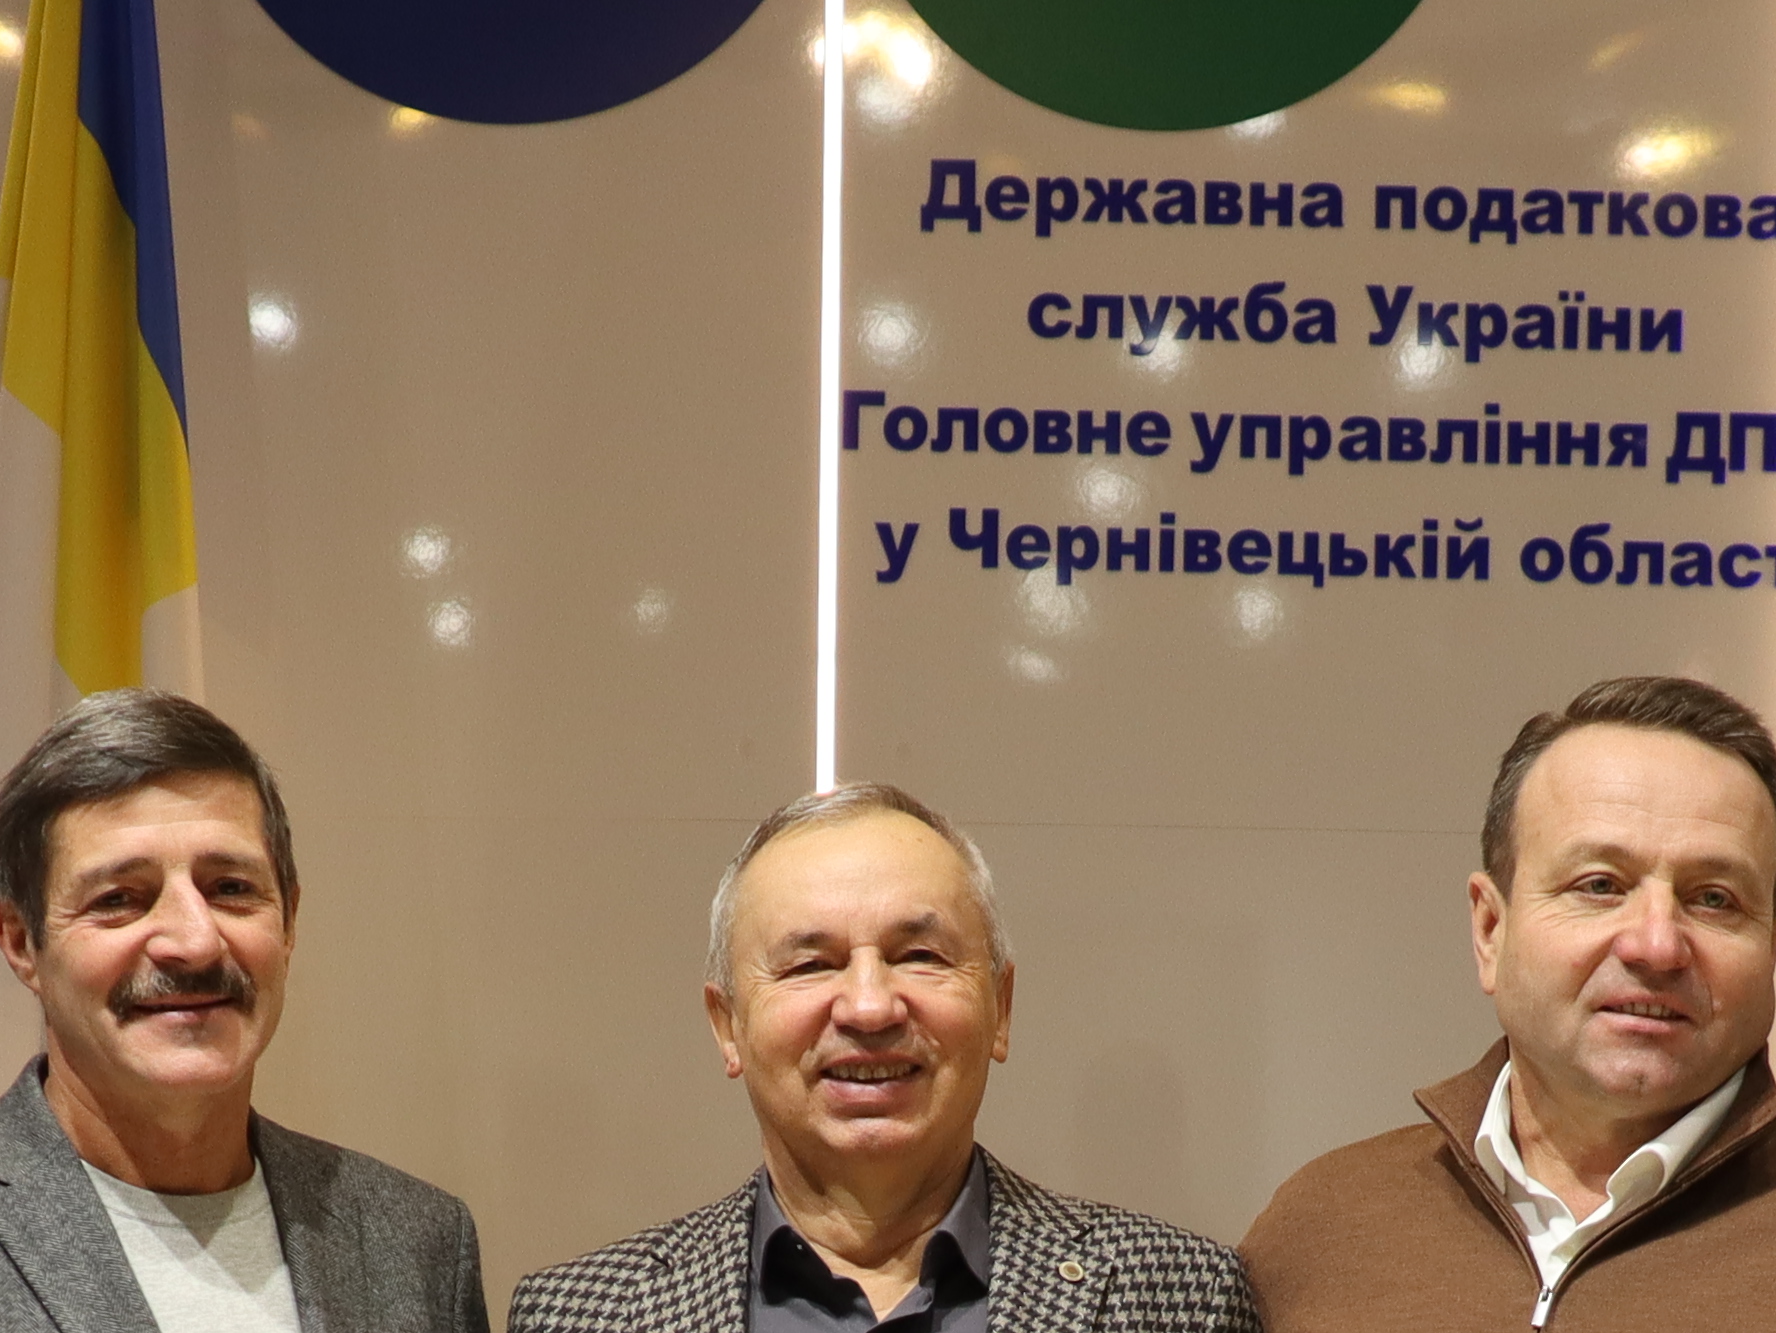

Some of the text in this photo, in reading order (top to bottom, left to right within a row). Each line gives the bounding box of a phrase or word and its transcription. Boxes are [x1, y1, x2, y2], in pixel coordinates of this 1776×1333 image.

[921, 158, 1344, 238] Державна
[1027, 281, 1684, 363] служба України
[842, 389, 1171, 456] Головне
[1189, 402, 1649, 476] управління
[875, 522, 920, 583] у
[949, 508, 1490, 588] Чернівецькій
